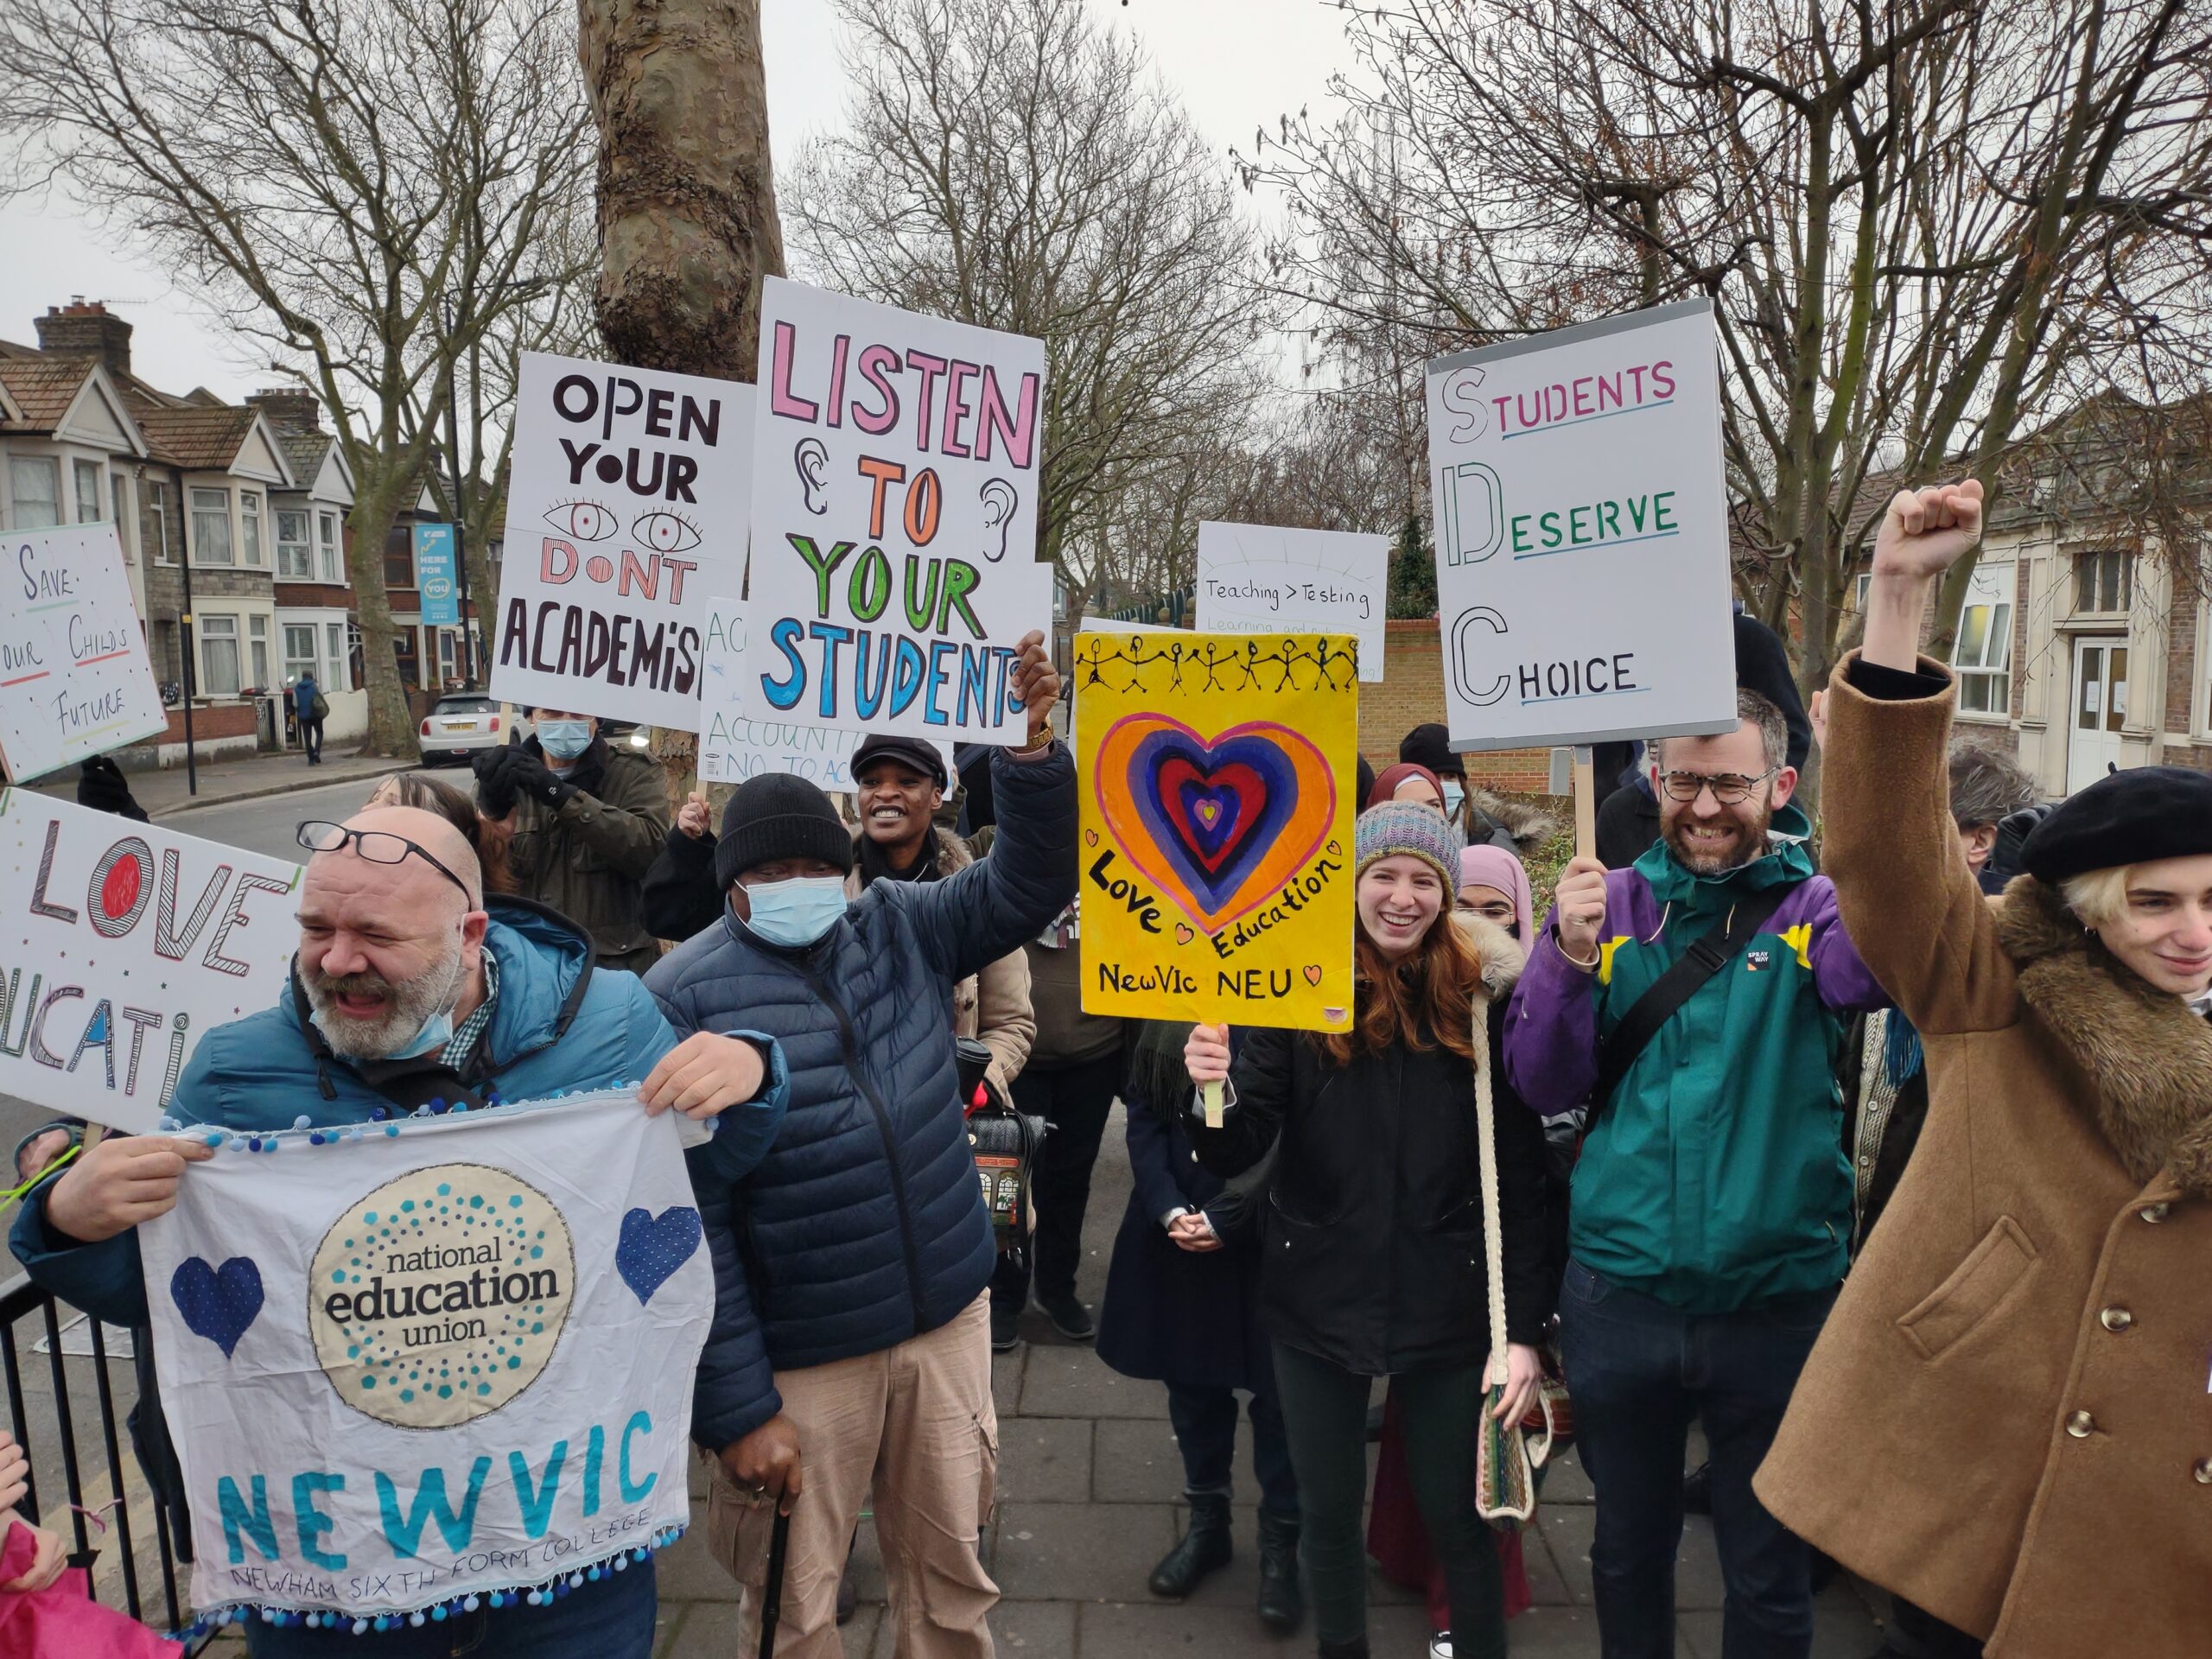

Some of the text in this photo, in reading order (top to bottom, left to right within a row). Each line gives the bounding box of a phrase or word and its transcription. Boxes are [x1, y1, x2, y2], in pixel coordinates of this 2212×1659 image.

[553, 374, 721, 447] OPEN
[772, 320, 1040, 470] LISTEN
[1442, 360, 1676, 444] STUDENTS
[559, 438, 698, 504] YOUR
[857, 454, 943, 547] TO
[1442, 461, 1679, 567] DESERVE
[420, 556, 448, 564] HERE
[785, 532, 988, 639] YOUR
[1205, 580, 1280, 611] Teaching
[1302, 583, 1370, 620] Testing
[1452, 606, 1637, 707] CHOICE
[29, 820, 290, 976] LOVE
[1089, 849, 1342, 959] Love Education
[1217, 969, 1292, 1000] NEU
[325, 1266, 560, 1324] education
[386, 1236, 502, 1274] national
[403, 1317, 486, 1348] union
[218, 1410, 658, 1573] NEWVIC
[231, 1507, 651, 1600] NEWHAM SIXTH FORM COLLEGE
